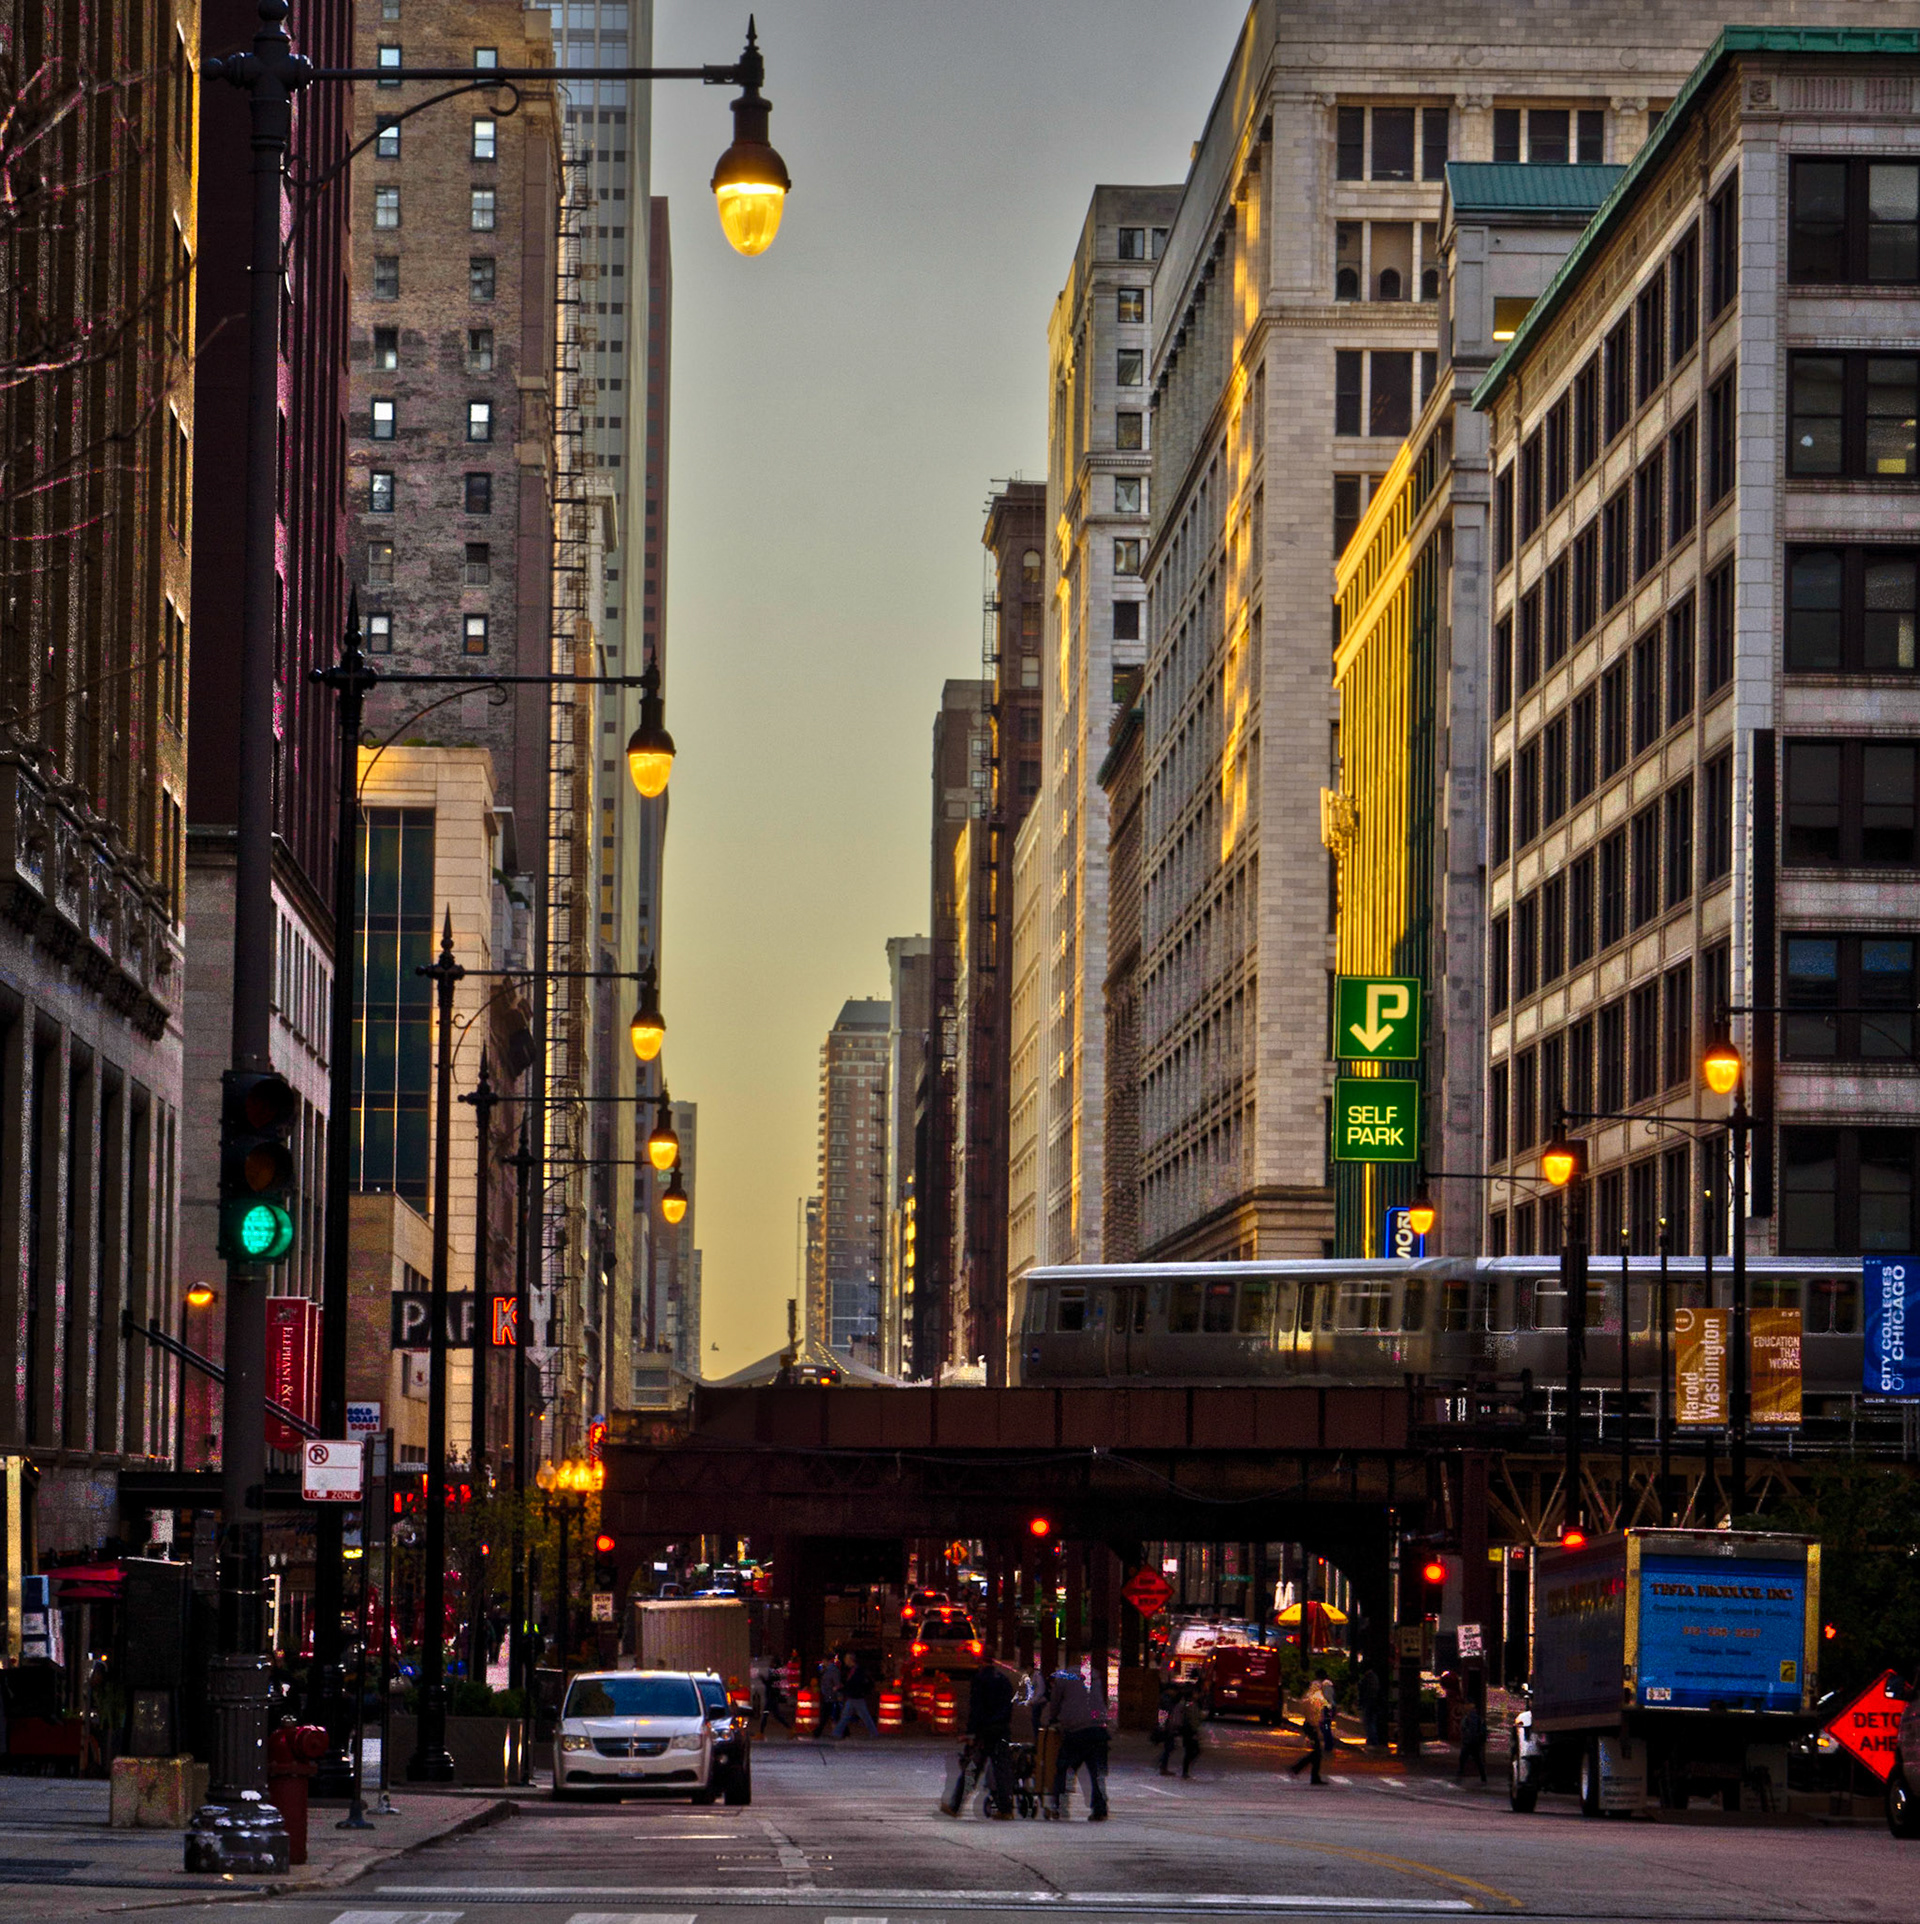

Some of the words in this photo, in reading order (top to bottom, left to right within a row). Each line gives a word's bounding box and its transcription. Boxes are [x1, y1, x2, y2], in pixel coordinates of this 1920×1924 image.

[1347, 1105, 1398, 1124] SELF
[1347, 1127, 1404, 1146] PARK
[1882, 1266, 1893, 1350] COLLEGES
[1892, 1265, 1905, 1361] CHICAGO
[402, 1297, 517, 1345] PRK
[1753, 1336, 1800, 1347] EDUCATION
[282, 1327, 294, 1382] ELEPHANT
[1780, 1347, 1800, 1358] THAT
[1699, 1318, 1725, 1420] Washington
[1769, 1359, 1800, 1369] WORKS
[1881, 1355, 1891, 1391] CITY
[1892, 1367, 1905, 1391] OF
[281, 1384, 294, 1396] &
[1681, 1372, 1699, 1420] Harold
[331, 1491, 356, 1499] ZONE
[1651, 1582, 1696, 1597] TESTA
